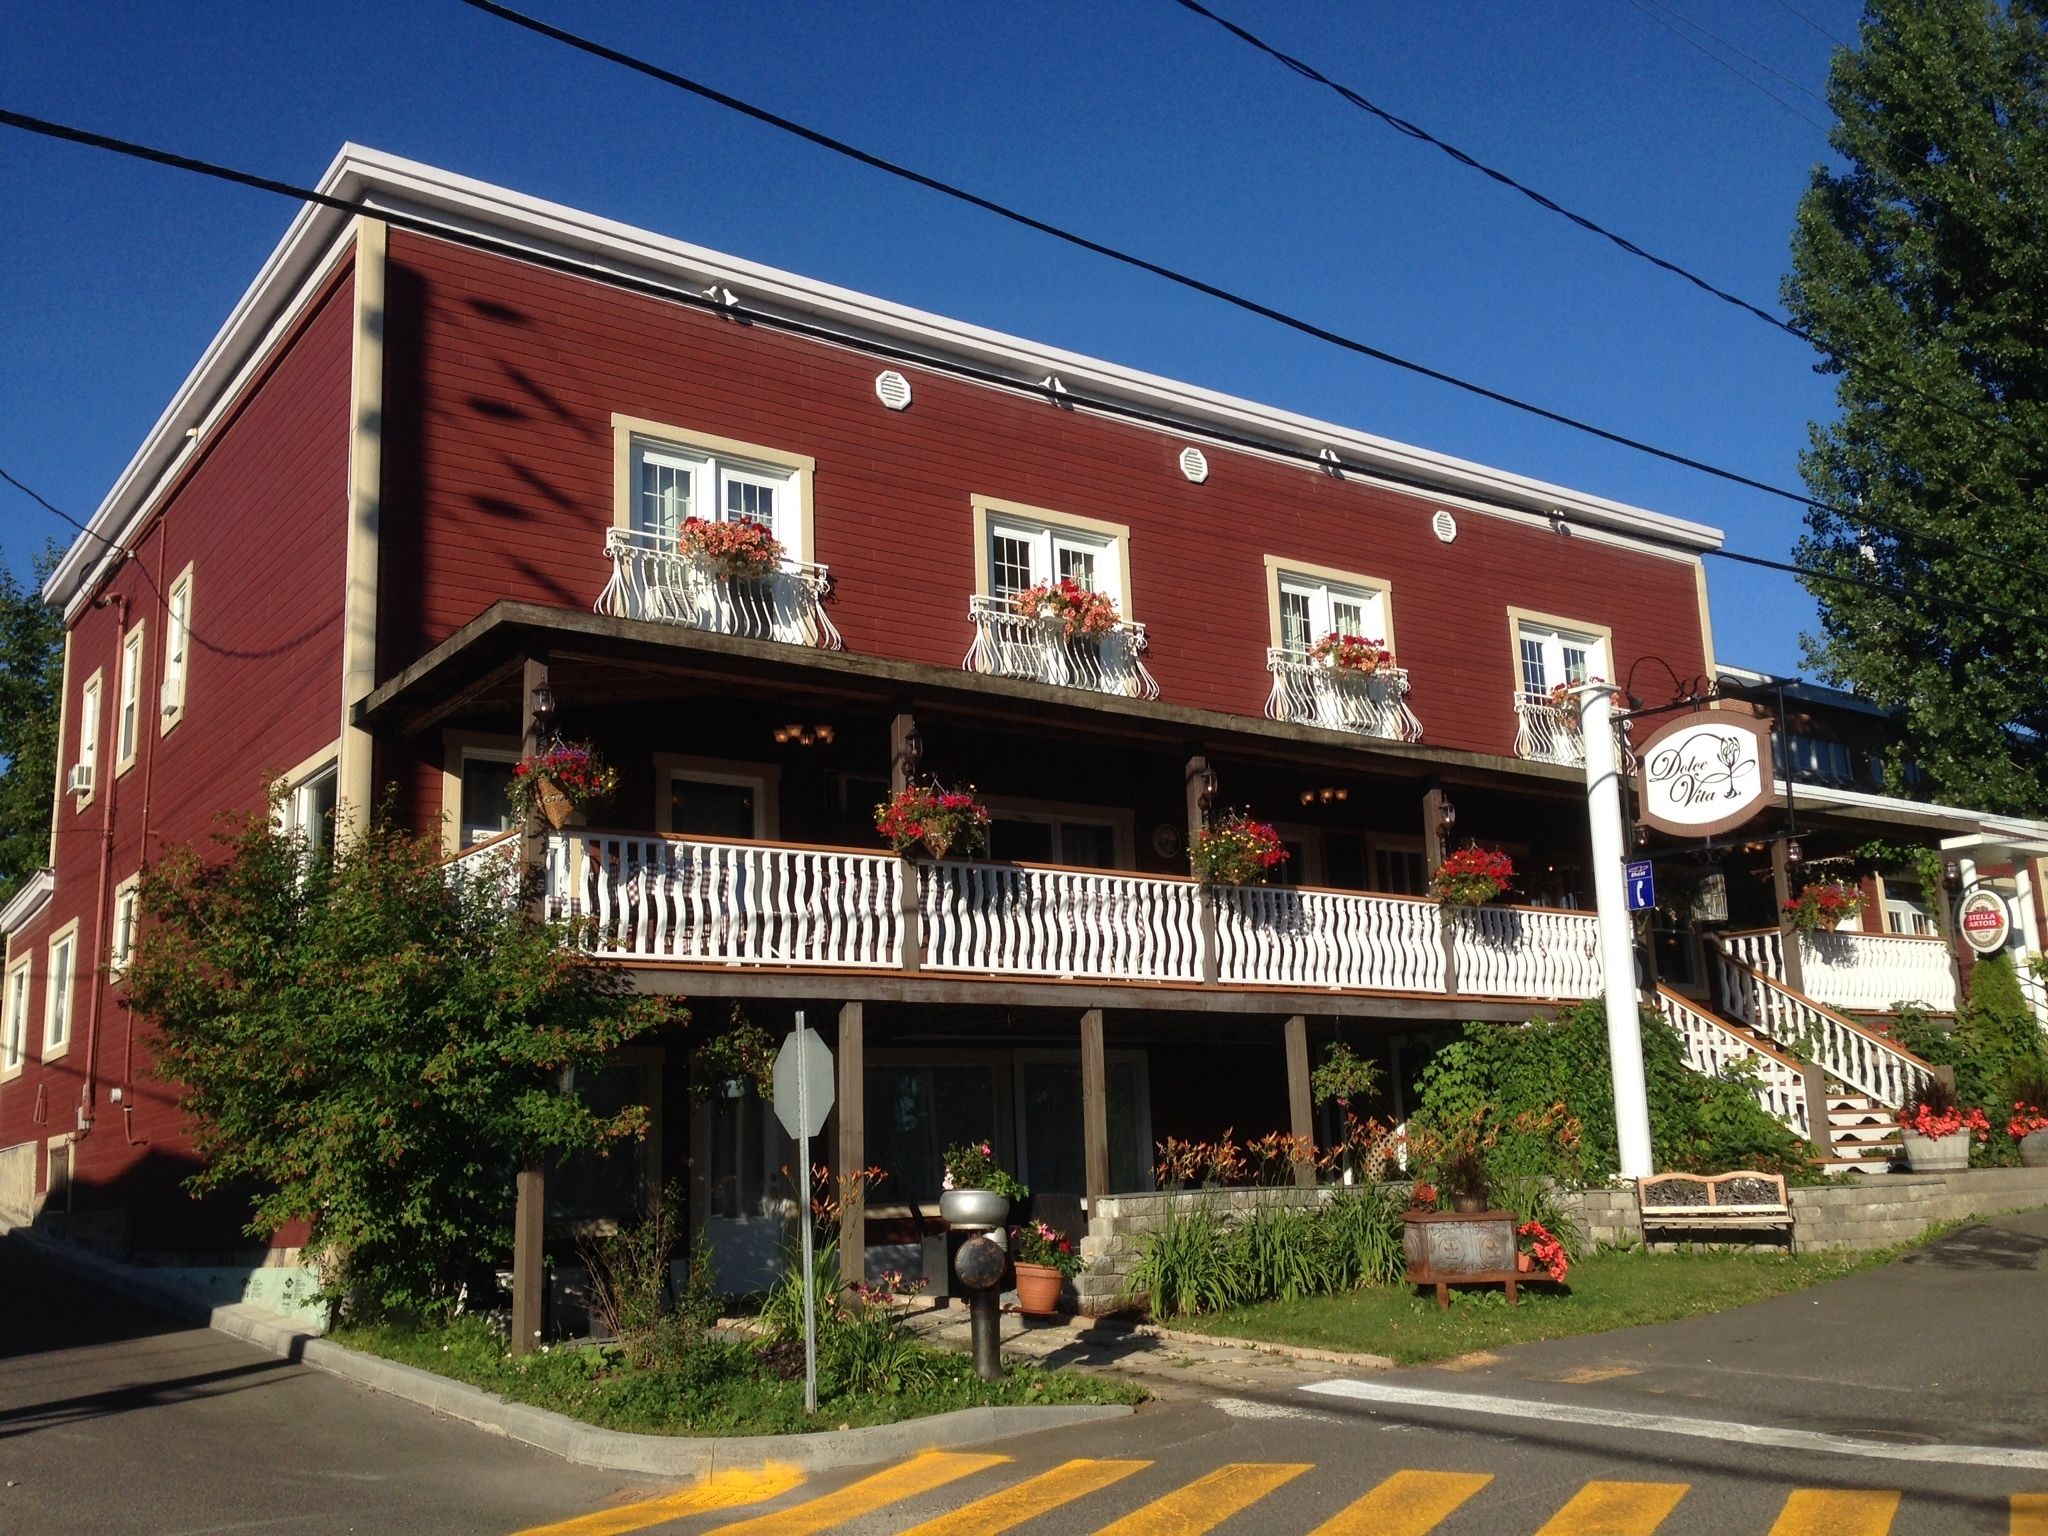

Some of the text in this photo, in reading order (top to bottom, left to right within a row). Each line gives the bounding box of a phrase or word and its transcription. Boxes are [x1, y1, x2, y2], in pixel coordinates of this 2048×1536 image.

[1649, 748, 1709, 782] Dolce
[1670, 773, 1716, 807] Vita
[1968, 913, 1996, 921] STELLA
[1968, 920, 1997, 928] ARTOIS
